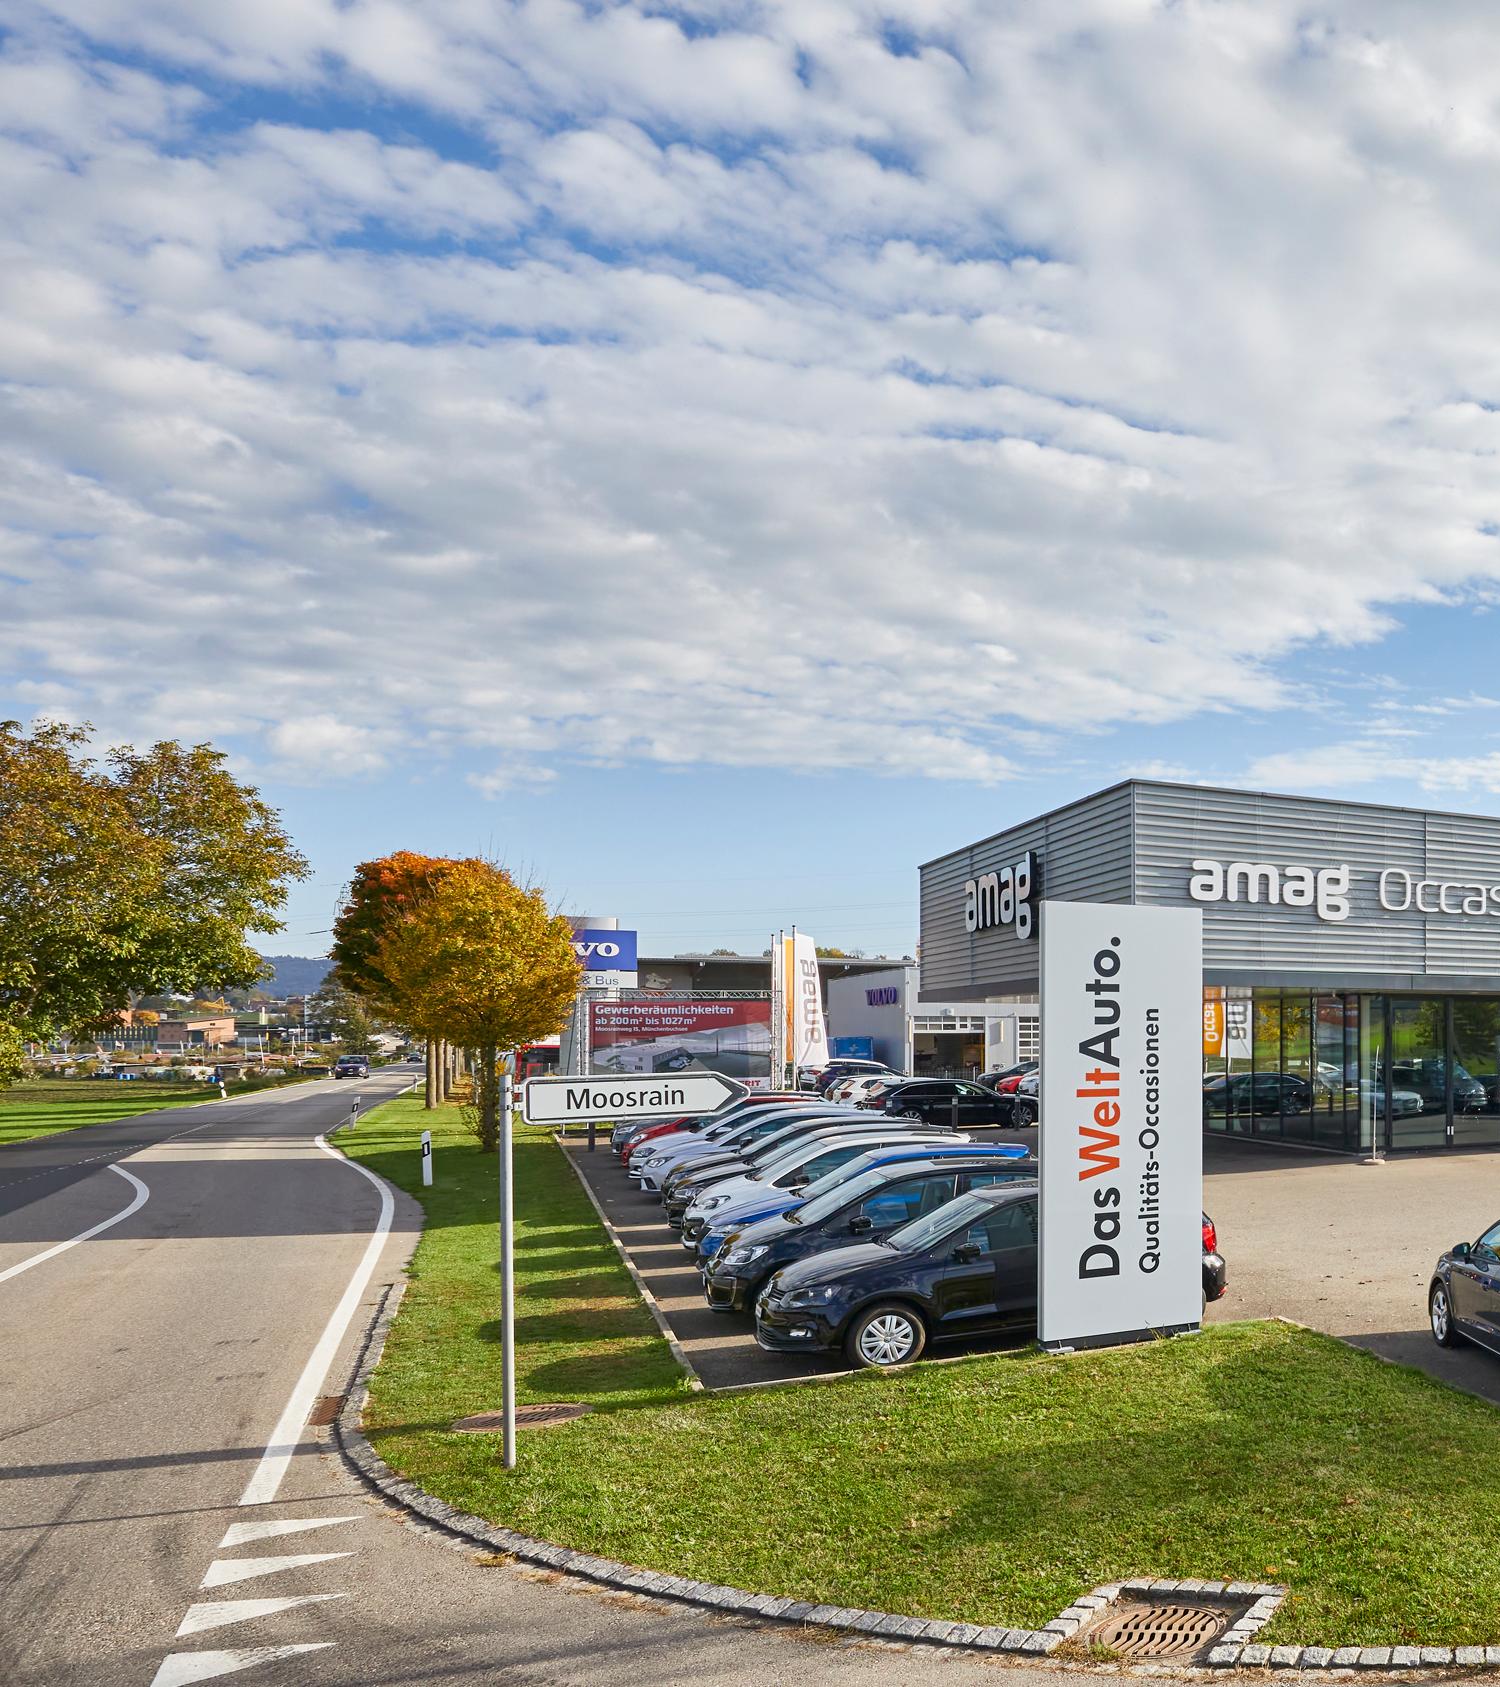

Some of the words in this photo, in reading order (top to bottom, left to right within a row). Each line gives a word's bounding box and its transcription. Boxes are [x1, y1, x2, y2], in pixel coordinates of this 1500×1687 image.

[965, 851, 1032, 939] amag
[1190, 859, 1350, 921] amag
[595, 975, 619, 986] Bus
[864, 986, 899, 1006] VOLVO
[595, 1005, 734, 1015] Gewerberäumlichkeiten
[595, 1017, 608, 1025] ab
[645, 1017, 661, 1025] bis
[1076, 936, 1121, 1182] WeltAuto.
[566, 1084, 685, 1110] Moosrain
[1138, 1008, 1161, 1274] Qualitäts-Occasionen
[1079, 1186, 1121, 1280] Das
